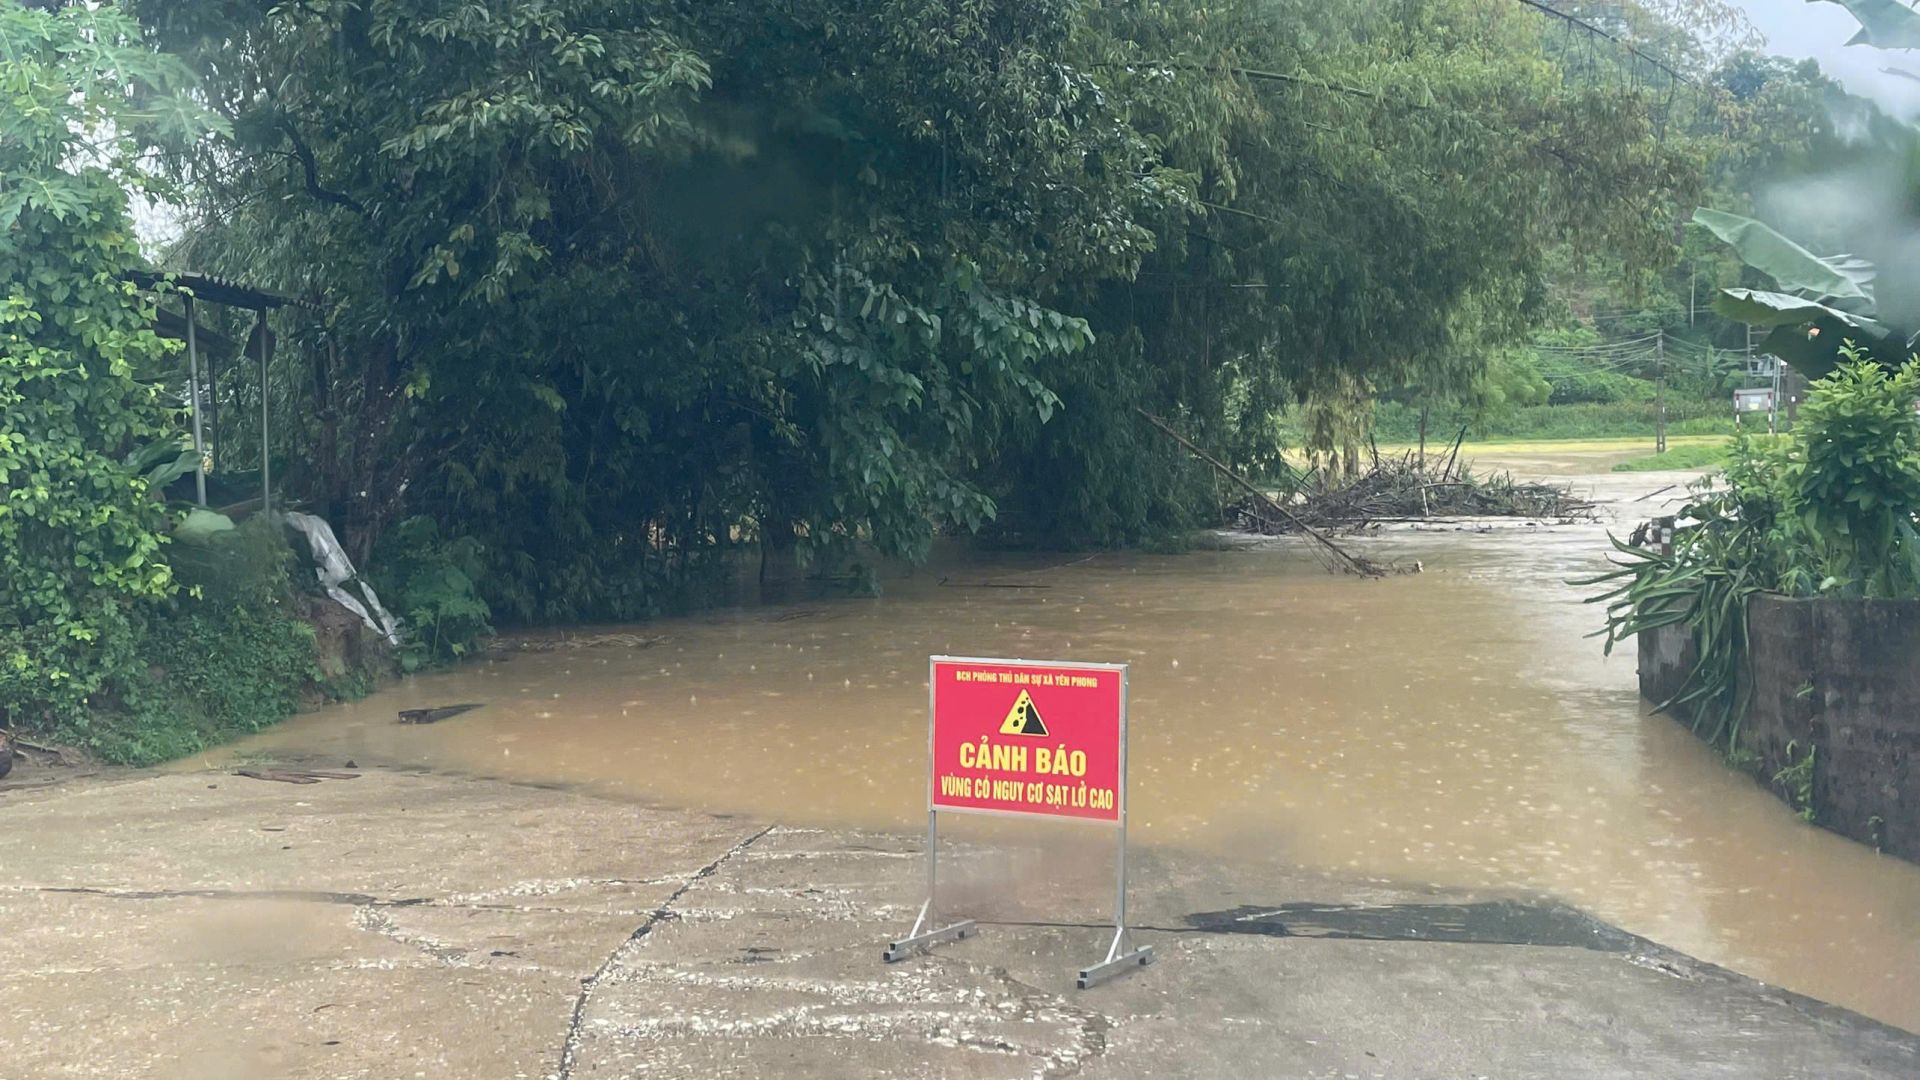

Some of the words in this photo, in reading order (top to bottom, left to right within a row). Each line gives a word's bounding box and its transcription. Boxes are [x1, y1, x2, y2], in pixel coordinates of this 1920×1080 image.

[956, 671, 971, 681] BCH
[1031, 674, 1042, 687] SỰ
[1055, 674, 1069, 686] YÊN
[1071, 676, 1097, 687] PHONG
[959, 736, 1027, 772] CẢNH
[1035, 744, 1086, 776] BÁO
[941, 773, 971, 797] VÙNG
[975, 775, 990, 799] CÓ
[993, 781, 1024, 802] NGUY
[1027, 783, 1044, 802] CƠ
[1046, 784, 1069, 809] SẠT
[1072, 780, 1087, 807] LỞ
[1090, 788, 1113, 809] CAO
